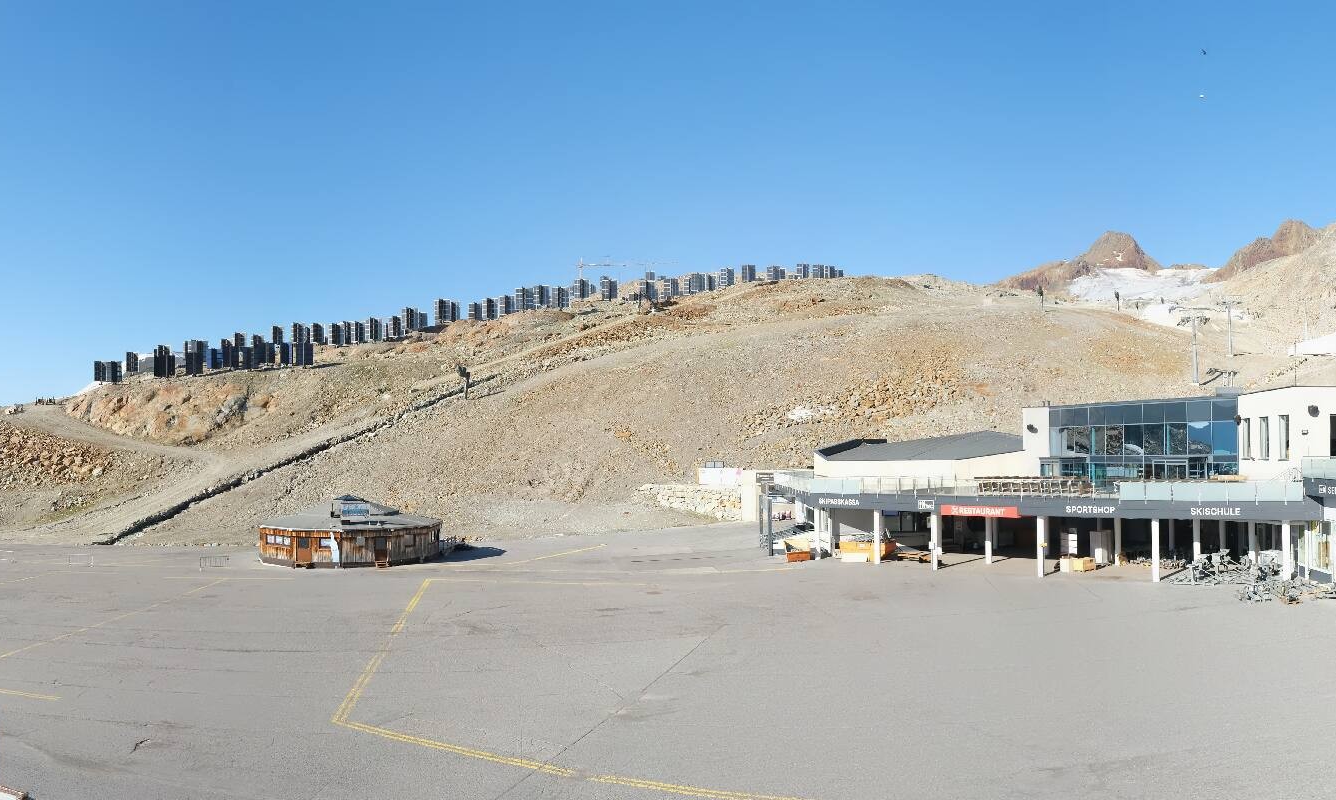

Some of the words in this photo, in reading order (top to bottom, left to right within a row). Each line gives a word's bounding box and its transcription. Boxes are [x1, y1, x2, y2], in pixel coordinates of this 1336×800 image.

[959, 506, 1006, 515] RESTAURANT
[1065, 505, 1116, 514] SPORTSHOP
[1190, 507, 1241, 516] SKISCHULE
